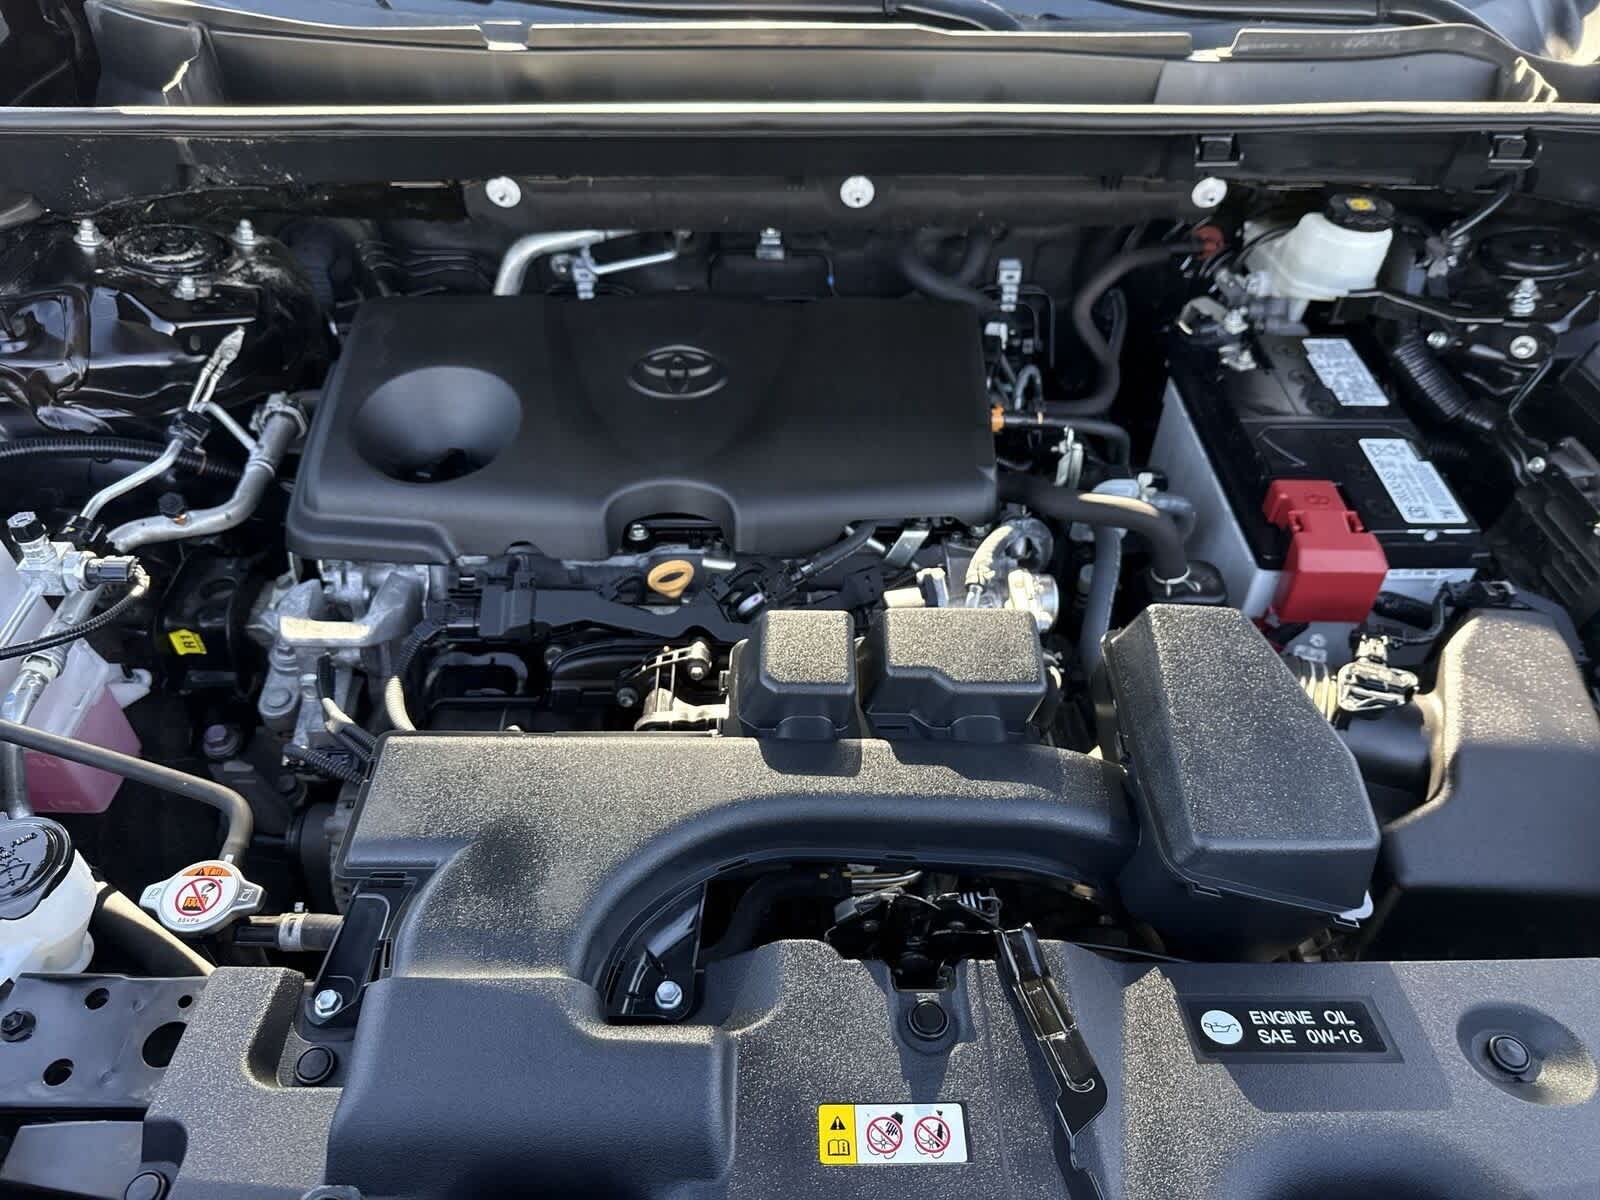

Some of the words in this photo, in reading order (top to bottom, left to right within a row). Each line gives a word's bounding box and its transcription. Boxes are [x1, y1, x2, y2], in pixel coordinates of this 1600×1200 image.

[1249, 1010, 1315, 1025] ENGINE
[1323, 1010, 1355, 1025] OIL
[1257, 1029, 1296, 1044] SAE
[1306, 1029, 1363, 1044] 0W-16
